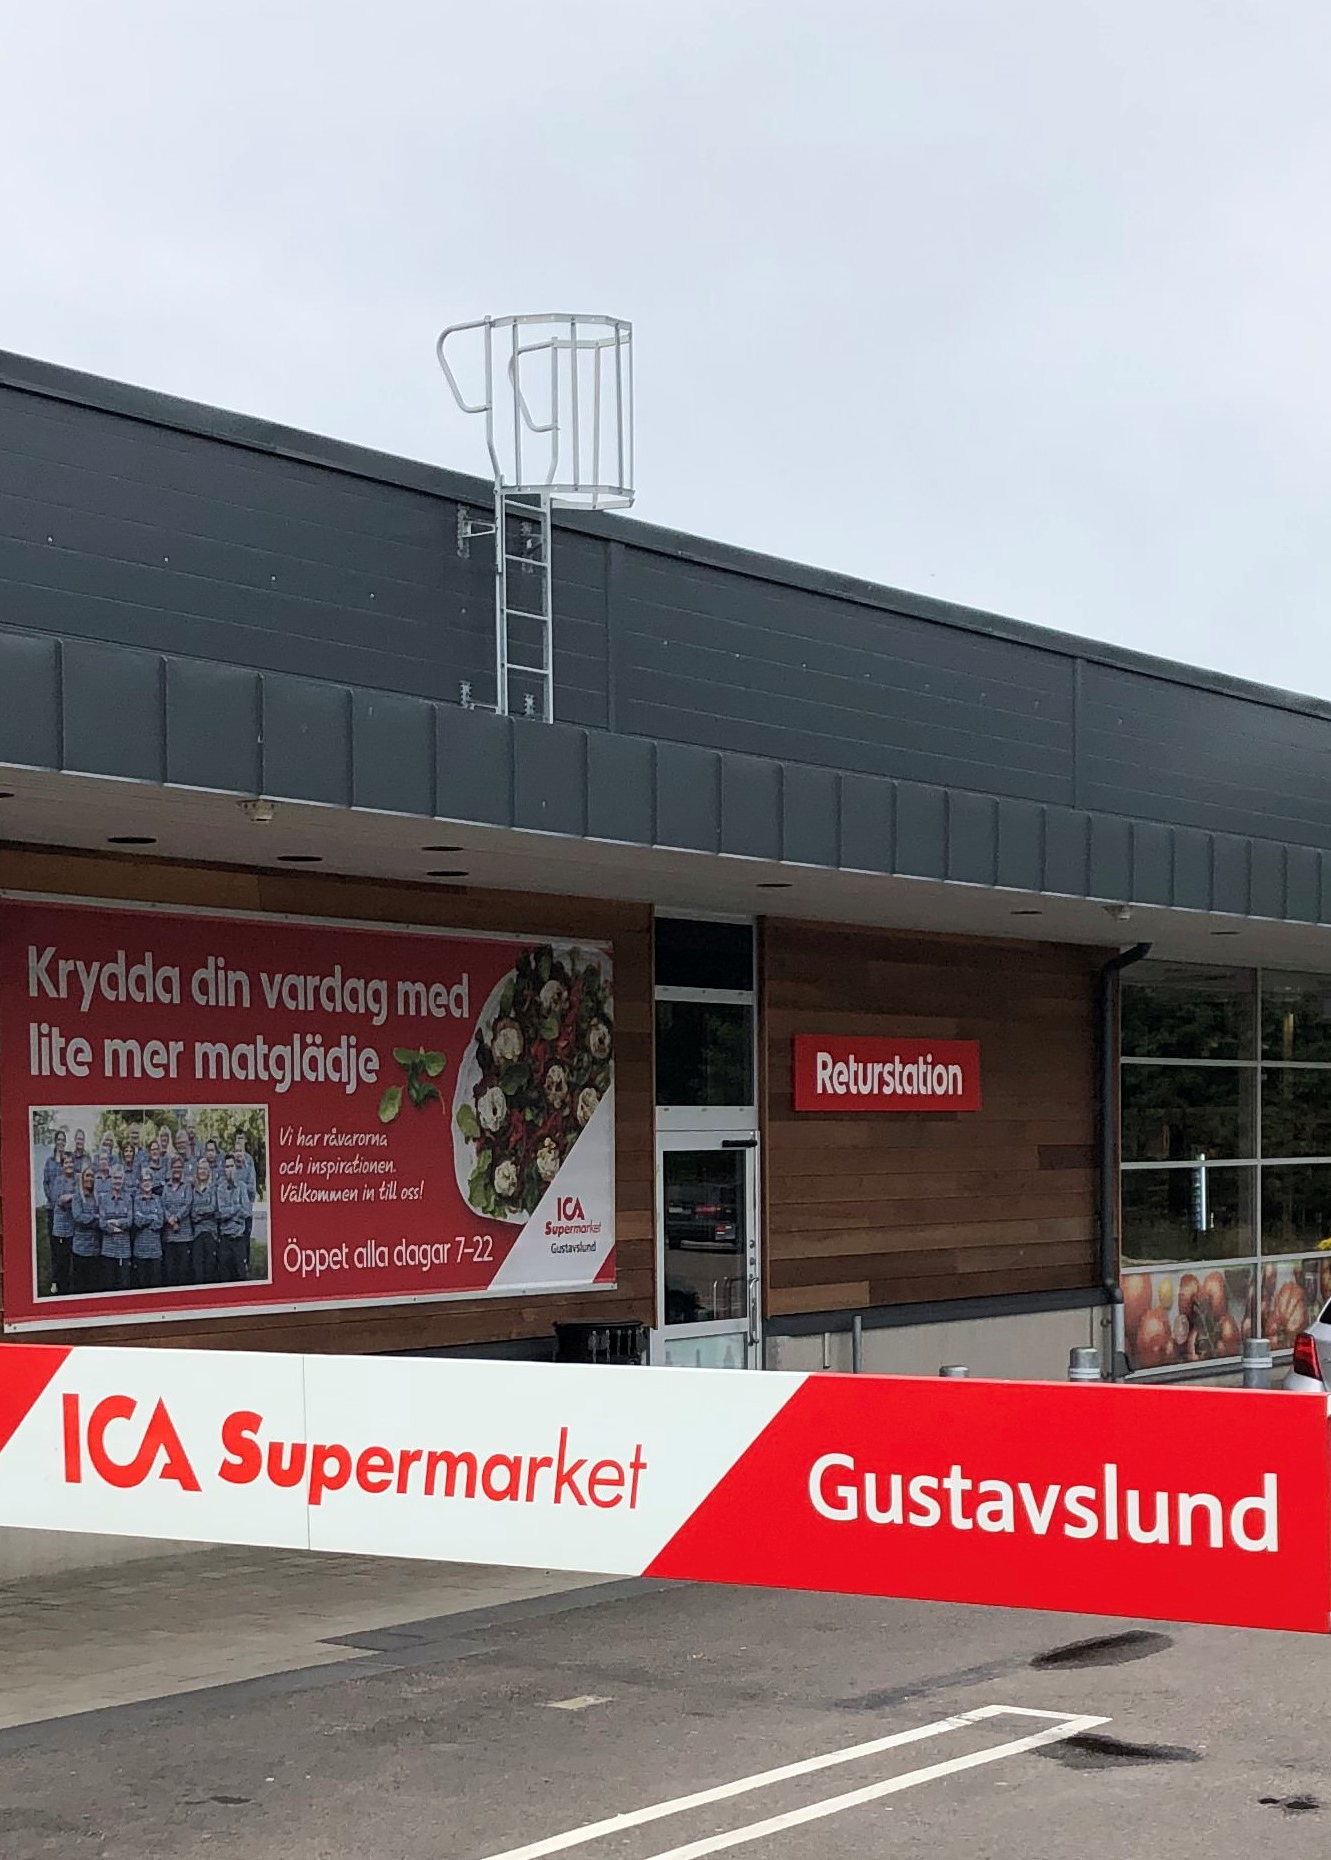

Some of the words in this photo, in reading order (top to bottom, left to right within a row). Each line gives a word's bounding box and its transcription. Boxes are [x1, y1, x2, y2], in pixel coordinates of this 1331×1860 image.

[28, 945, 181, 1012] Krydda
[191, 956, 251, 1008] din
[260, 964, 388, 1026] vardag
[397, 972, 469, 1018] med
[30, 1022, 93, 1077] lite
[104, 1038, 184, 1078] mer
[195, 1033, 380, 1095] matglädje
[816, 1051, 963, 1095] Returstation
[279, 1125, 293, 1147] Vi
[296, 1127, 321, 1146] har
[323, 1127, 388, 1147] råvarorna
[279, 1154, 303, 1175] och
[307, 1153, 397, 1180] inspirationen.
[279, 1182, 358, 1203] Välkommen
[362, 1184, 375, 1202] in
[379, 1180, 397, 1200] till
[400, 1180, 425, 1200] oss!
[557, 1196, 585, 1221] ICA
[545, 1219, 602, 1238] Supermarket
[283, 1238, 349, 1277] Öppet
[354, 1239, 388, 1269] alla
[393, 1238, 451, 1271] dagar
[551, 1240, 597, 1254] Gustavslund
[62, 1392, 202, 1493] ICA
[217, 1410, 647, 1510] Supermarket
[807, 1452, 1280, 1553] Gustavslund
